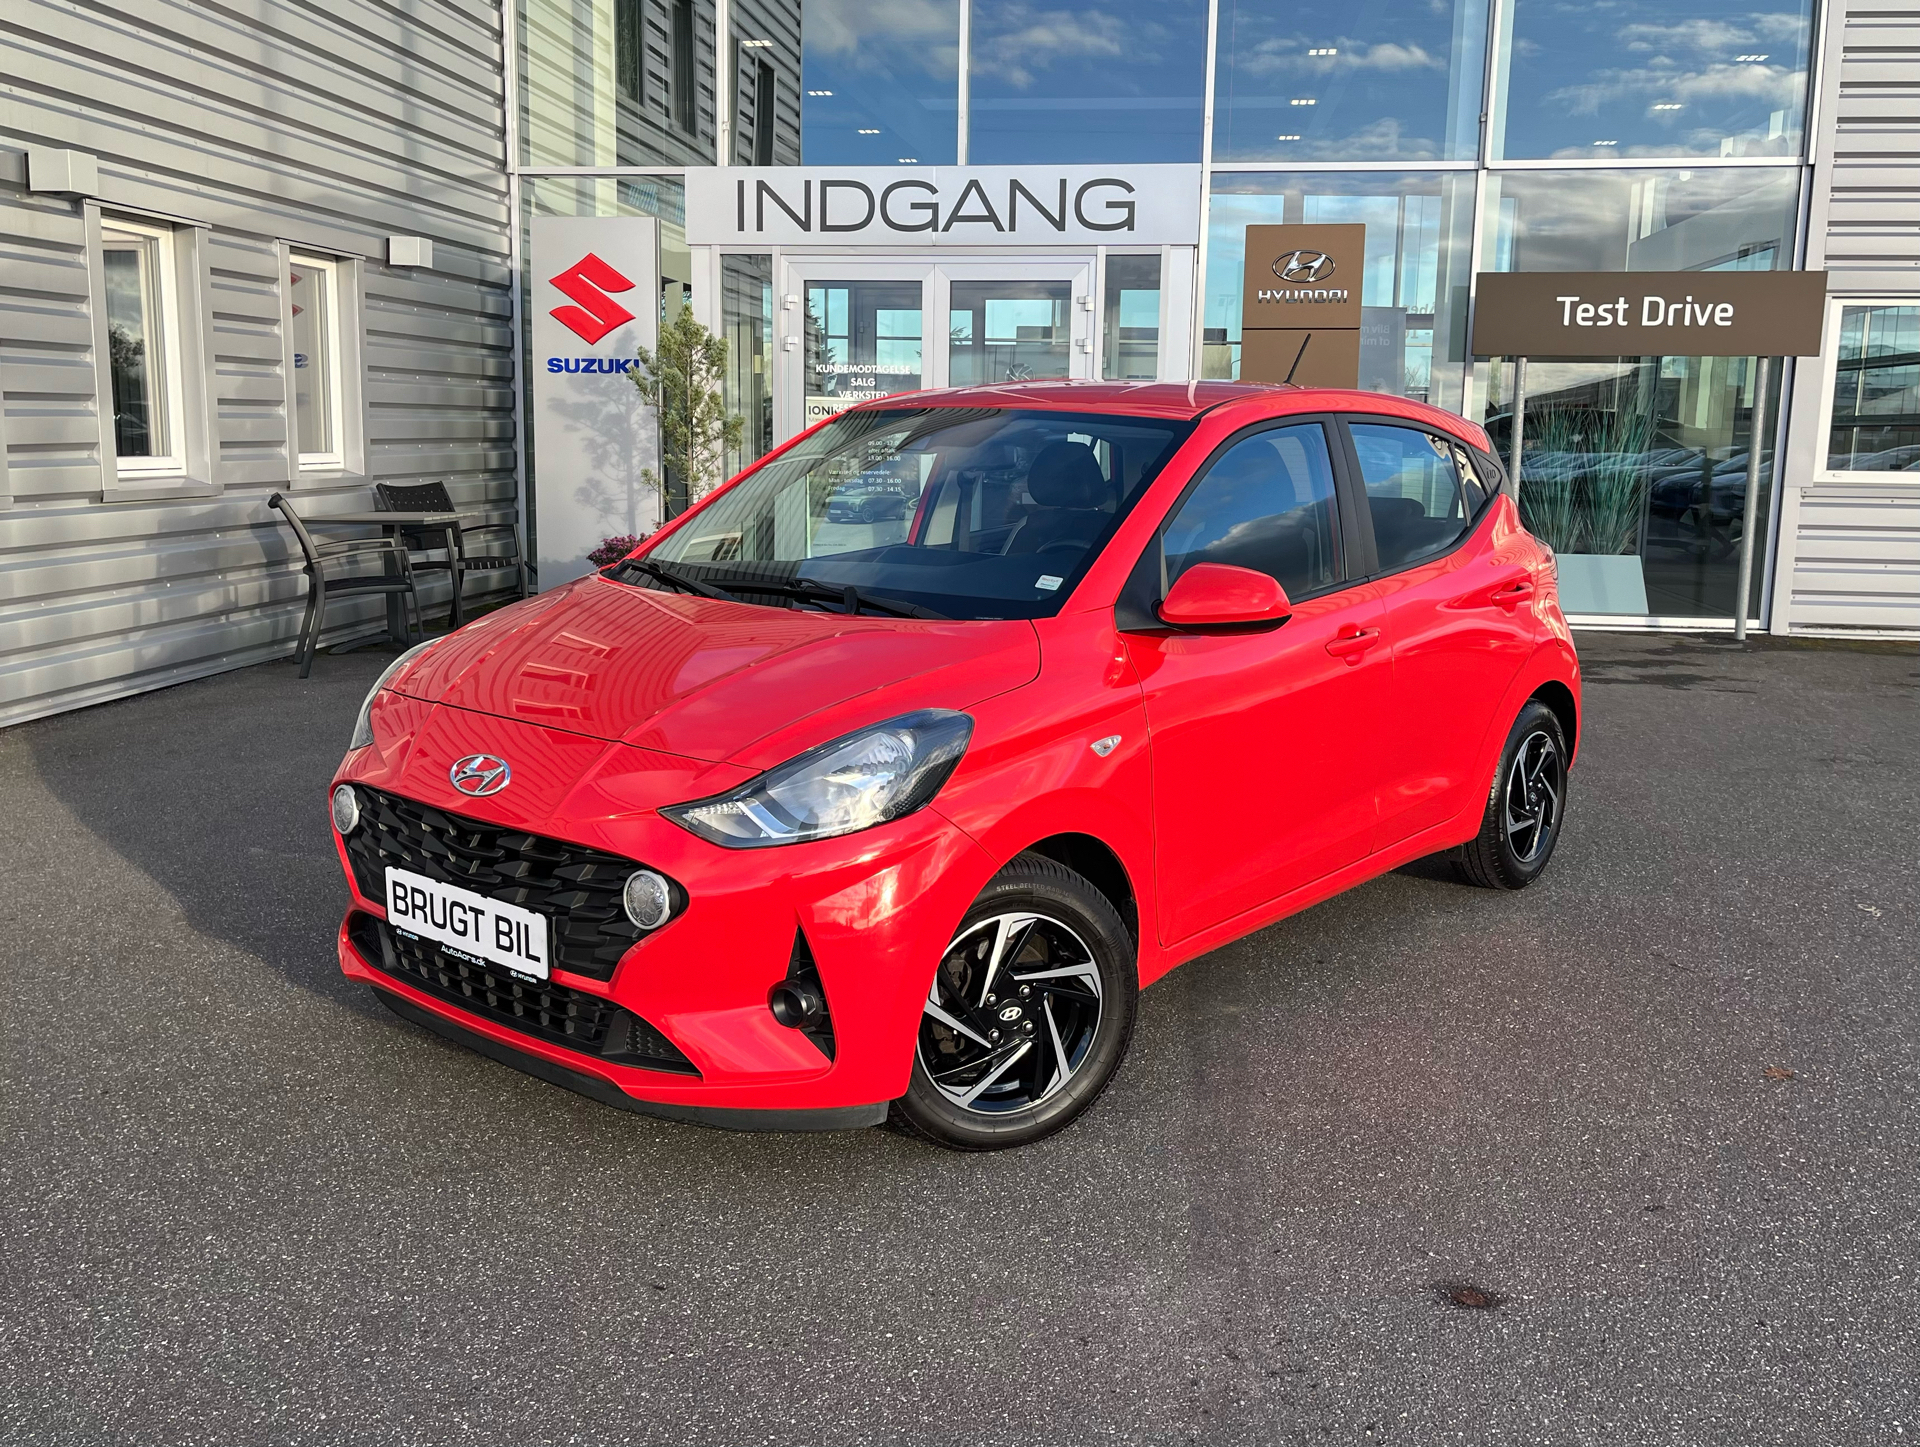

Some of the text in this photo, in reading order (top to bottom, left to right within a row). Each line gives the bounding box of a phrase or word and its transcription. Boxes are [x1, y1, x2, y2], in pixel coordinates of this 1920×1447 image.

[736, 178, 1136, 233] INDGANG
[1257, 289, 1348, 304] HYUNDAI
[1556, 294, 1735, 327] Test Drive
[815, 364, 911, 374] KUNDEMODTAGELSE
[850, 377, 876, 387] SALG
[838, 390, 888, 400] VÆRKSTED
[996, 883, 1018, 892] STEEL
[1019, 882, 1045, 890] BELTED
[392, 880, 541, 964] BRUGT BIL
